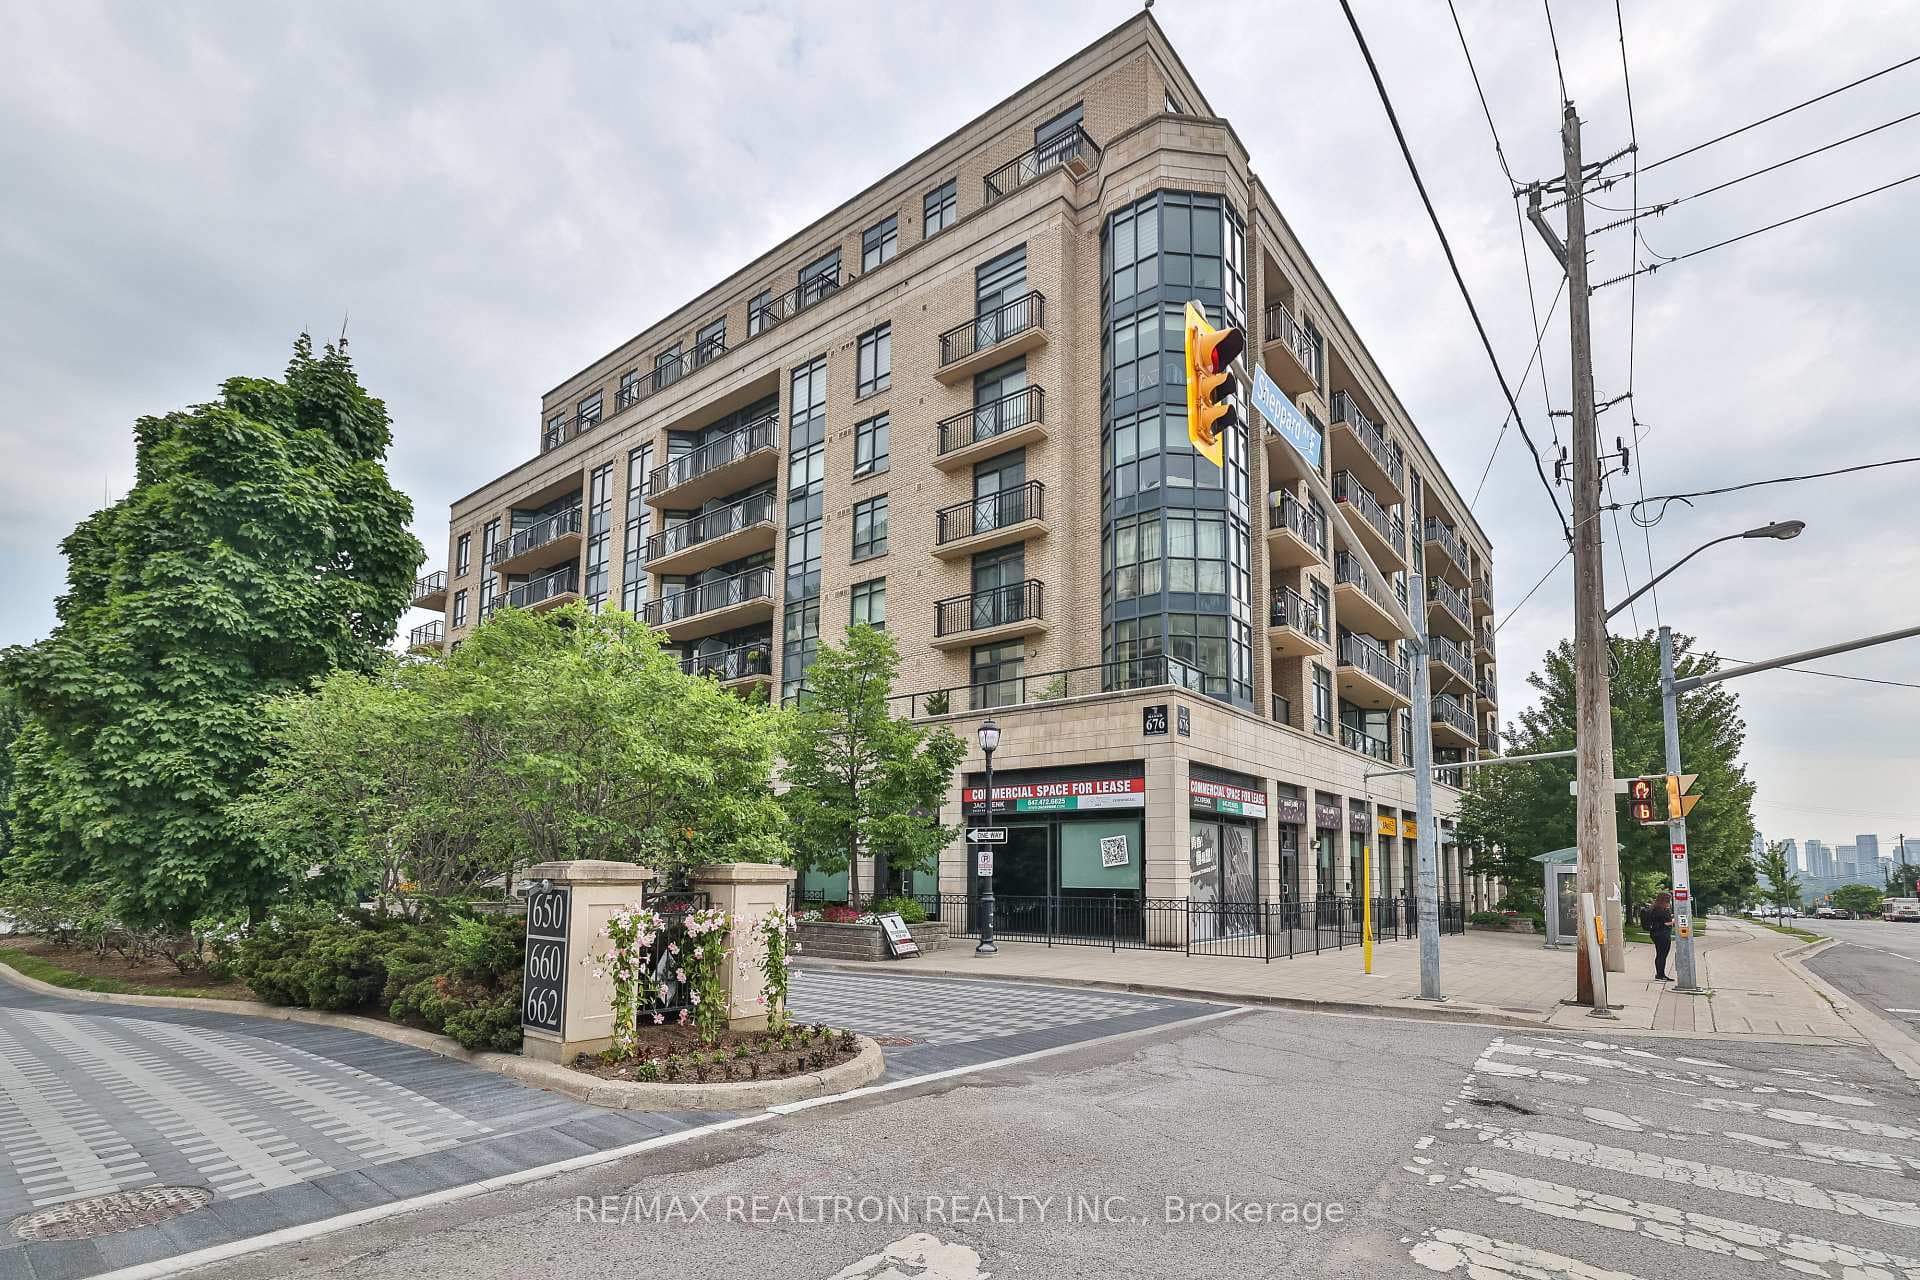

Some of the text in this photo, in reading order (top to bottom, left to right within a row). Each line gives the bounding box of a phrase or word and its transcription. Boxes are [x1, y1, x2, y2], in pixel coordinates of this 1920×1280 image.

[1256, 374, 1302, 440] Sheppard
[1146, 717, 1165, 731] 676
[972, 780, 1131, 801] COMERCIAL SPACE FOR LEASE
[1190, 780, 1226, 798] COMMERCIAL
[1226, 786, 1241, 801] SPACE
[1241, 789, 1251, 802] FOR
[1251, 792, 1265, 805] LEASE
[533, 893, 563, 929] 650
[530, 943, 561, 981] 660
[527, 986, 558, 1026] 662
